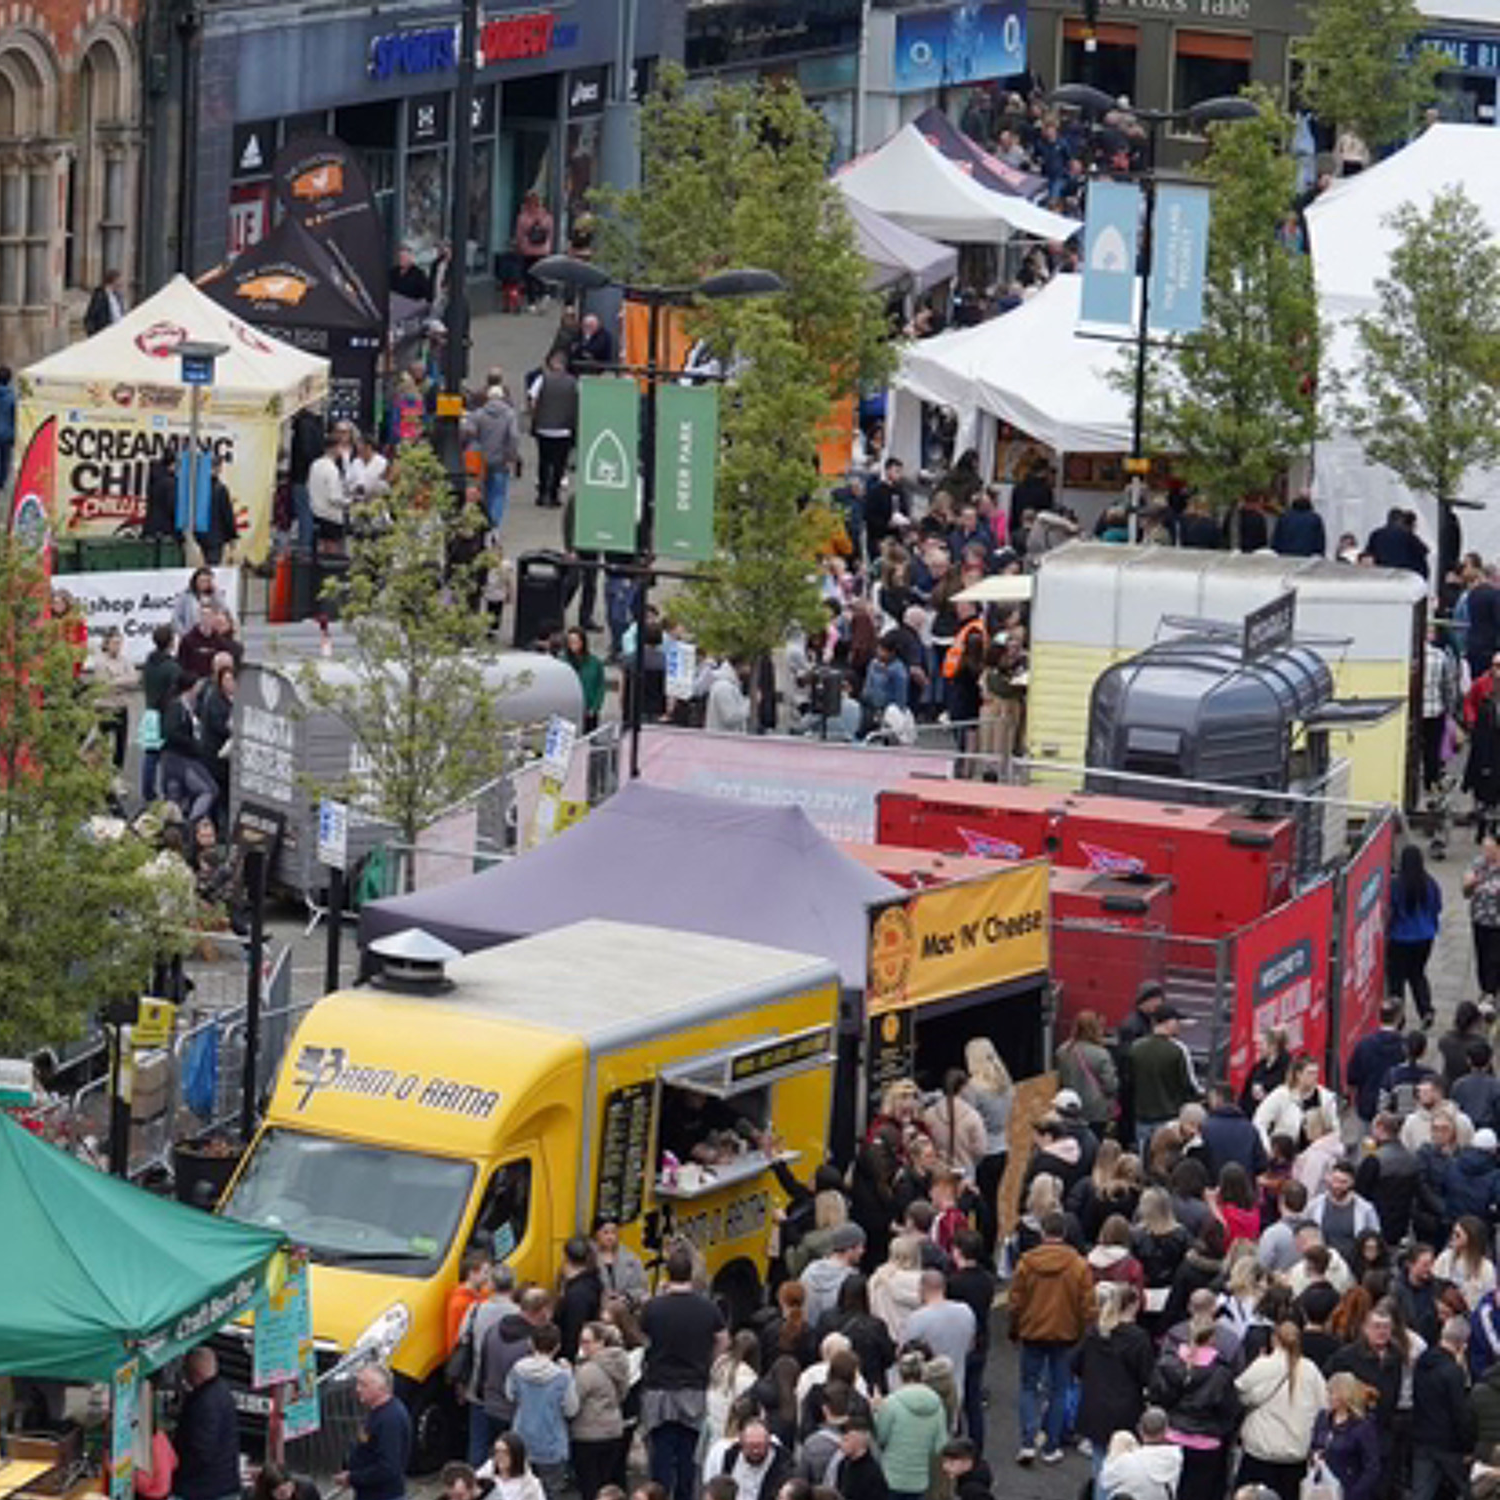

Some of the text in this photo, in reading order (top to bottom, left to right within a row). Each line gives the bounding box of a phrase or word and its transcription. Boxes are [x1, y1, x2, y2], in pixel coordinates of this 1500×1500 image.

[69, 462, 143, 499] CHI
[921, 932, 955, 960] Mac
[983, 909, 1043, 944] Cheese
